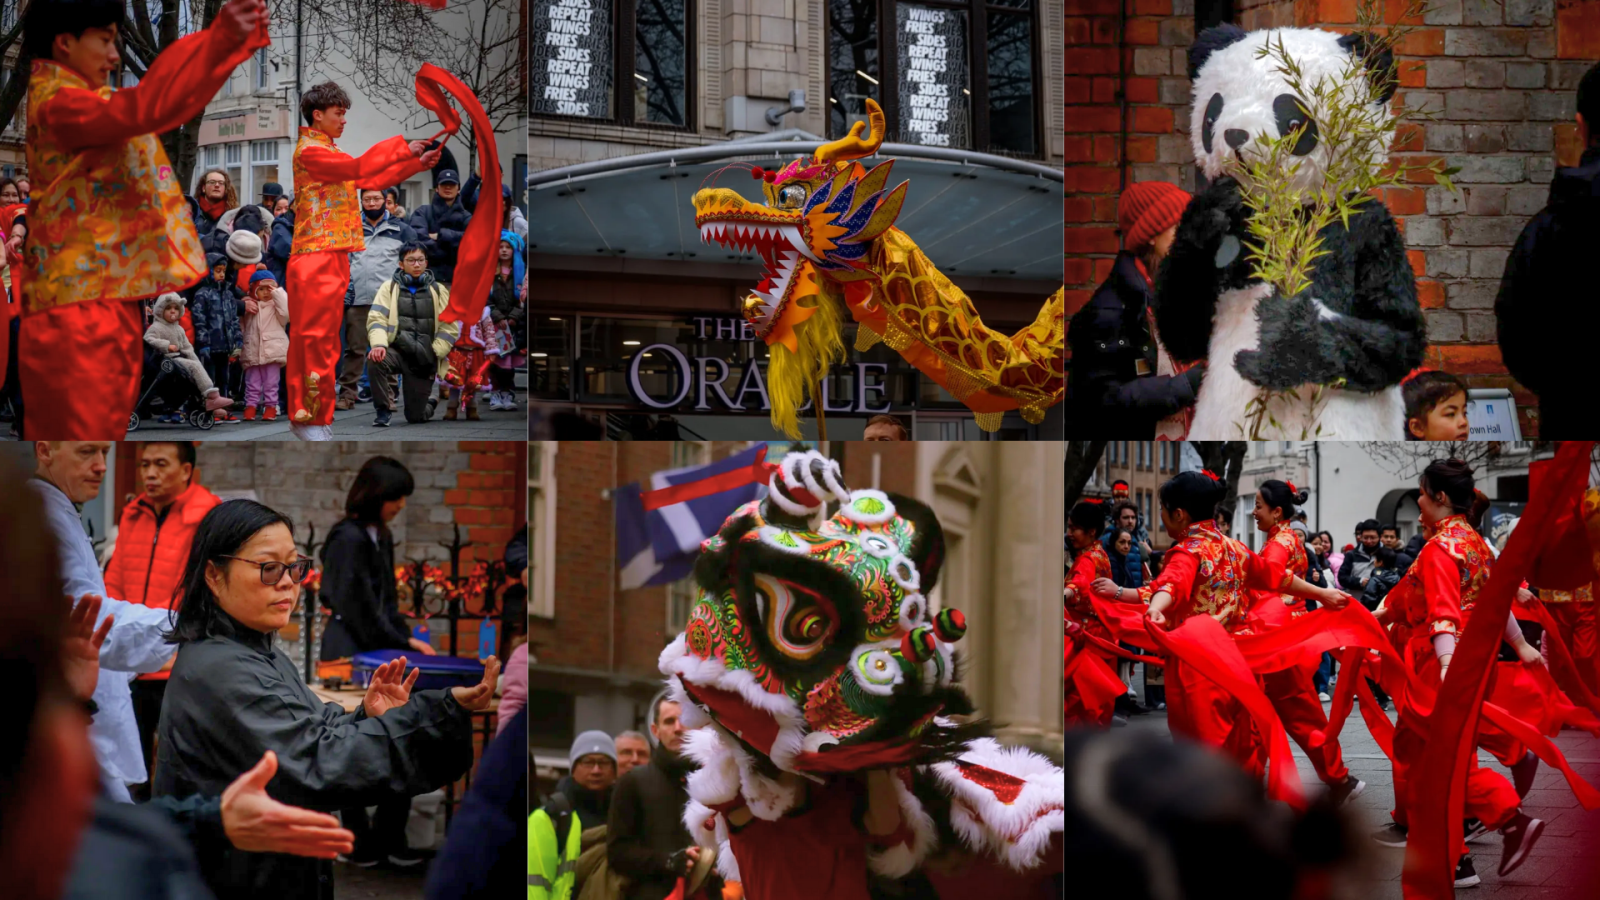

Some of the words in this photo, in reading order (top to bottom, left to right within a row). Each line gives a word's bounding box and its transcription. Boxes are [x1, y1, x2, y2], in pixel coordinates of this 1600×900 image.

[548, 5, 593, 22] REPEAT
[909, 8, 945, 23] WINGS
[550, 18, 591, 36] WINGS
[905, 20, 935, 35] FRIES
[545, 32, 578, 47] FRIES
[916, 33, 946, 48] SIDES
[557, 47, 591, 62] SIDES
[908, 44, 949, 60] REPEAT
[547, 59, 592, 76] REPEAT
[910, 57, 947, 72] WINGS
[549, 72, 590, 90] WINGS
[907, 69, 936, 84] FRIES
[544, 85, 577, 101] FRIES
[918, 82, 948, 97] SIDES
[556, 100, 589, 116] SIDES
[909, 94, 950, 109] REPEAT
[912, 106, 949, 122] WINGS
[908, 119, 938, 133] FRIES
[920, 132, 950, 147] SIDES
[693, 317, 756, 341] THE
[630, 343, 891, 413] ORALE
[1469, 426, 1485, 434] own
[1486, 424, 1502, 434] Hall
